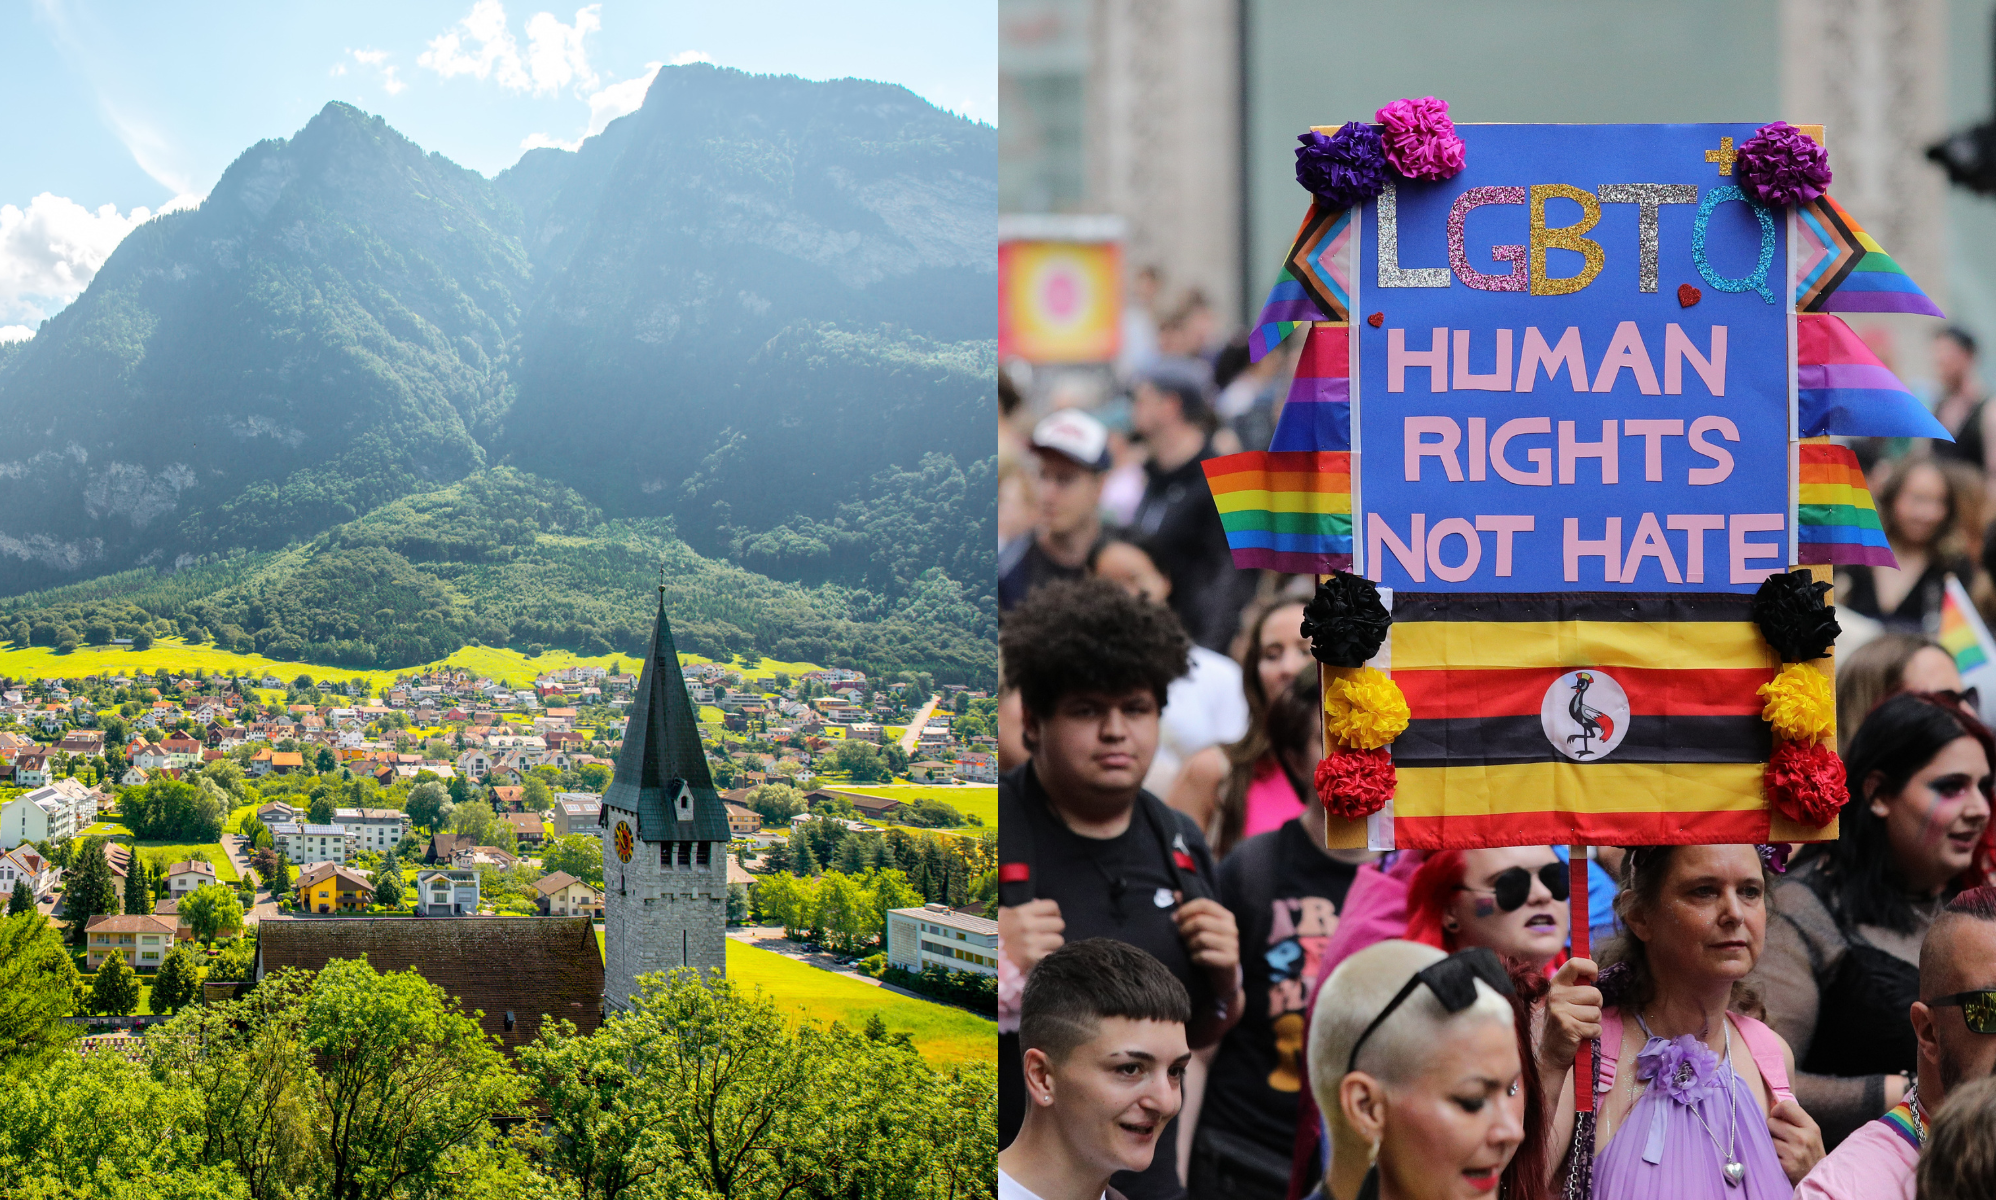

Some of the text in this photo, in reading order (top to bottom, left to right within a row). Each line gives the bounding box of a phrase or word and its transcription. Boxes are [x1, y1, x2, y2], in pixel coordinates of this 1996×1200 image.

[1387, 321, 1728, 397] HUMAN
[1404, 416, 1741, 487] RIGHTS
[1367, 512, 1786, 585] NOT HATE
